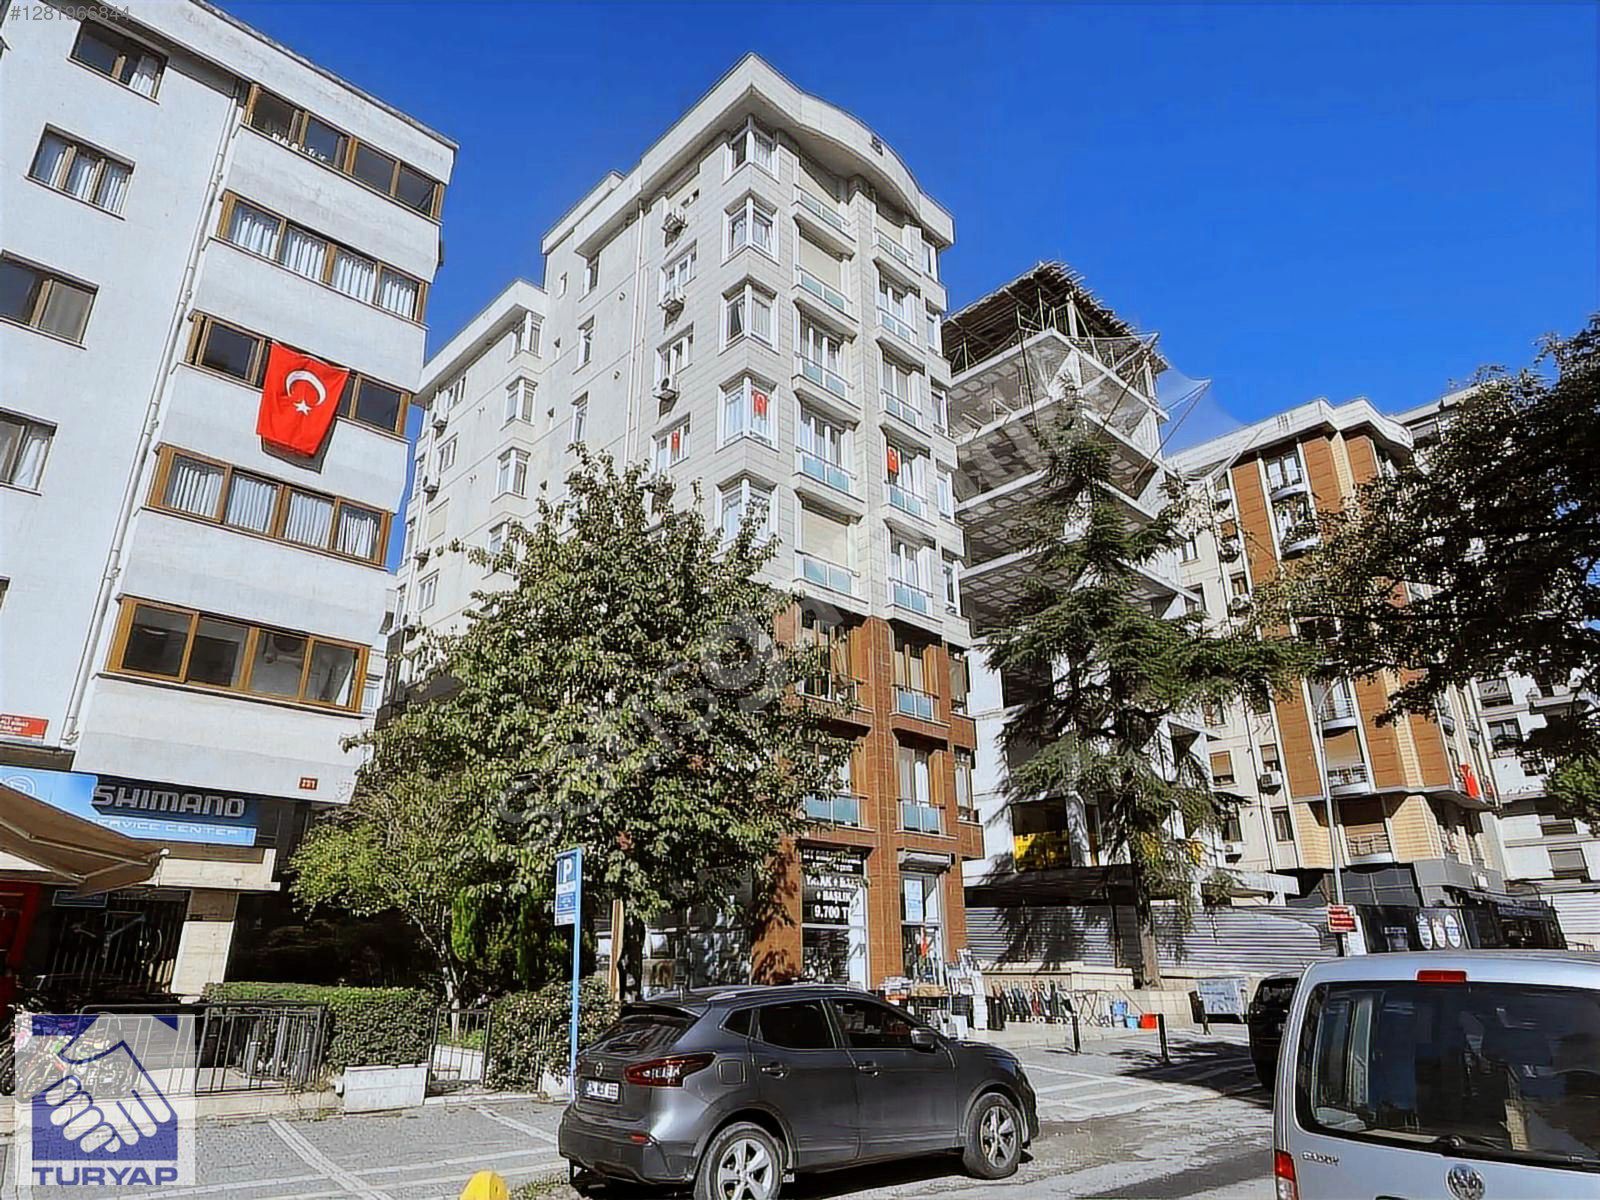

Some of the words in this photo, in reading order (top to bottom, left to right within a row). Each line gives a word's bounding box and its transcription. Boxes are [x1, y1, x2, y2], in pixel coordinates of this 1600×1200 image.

[91, 785, 246, 817] SHIMANO
[96, 818, 160, 831] ERVICE
[165, 824, 239, 836] CENTER
[563, 858, 573, 883] P
[814, 904, 840, 919] 9.700
